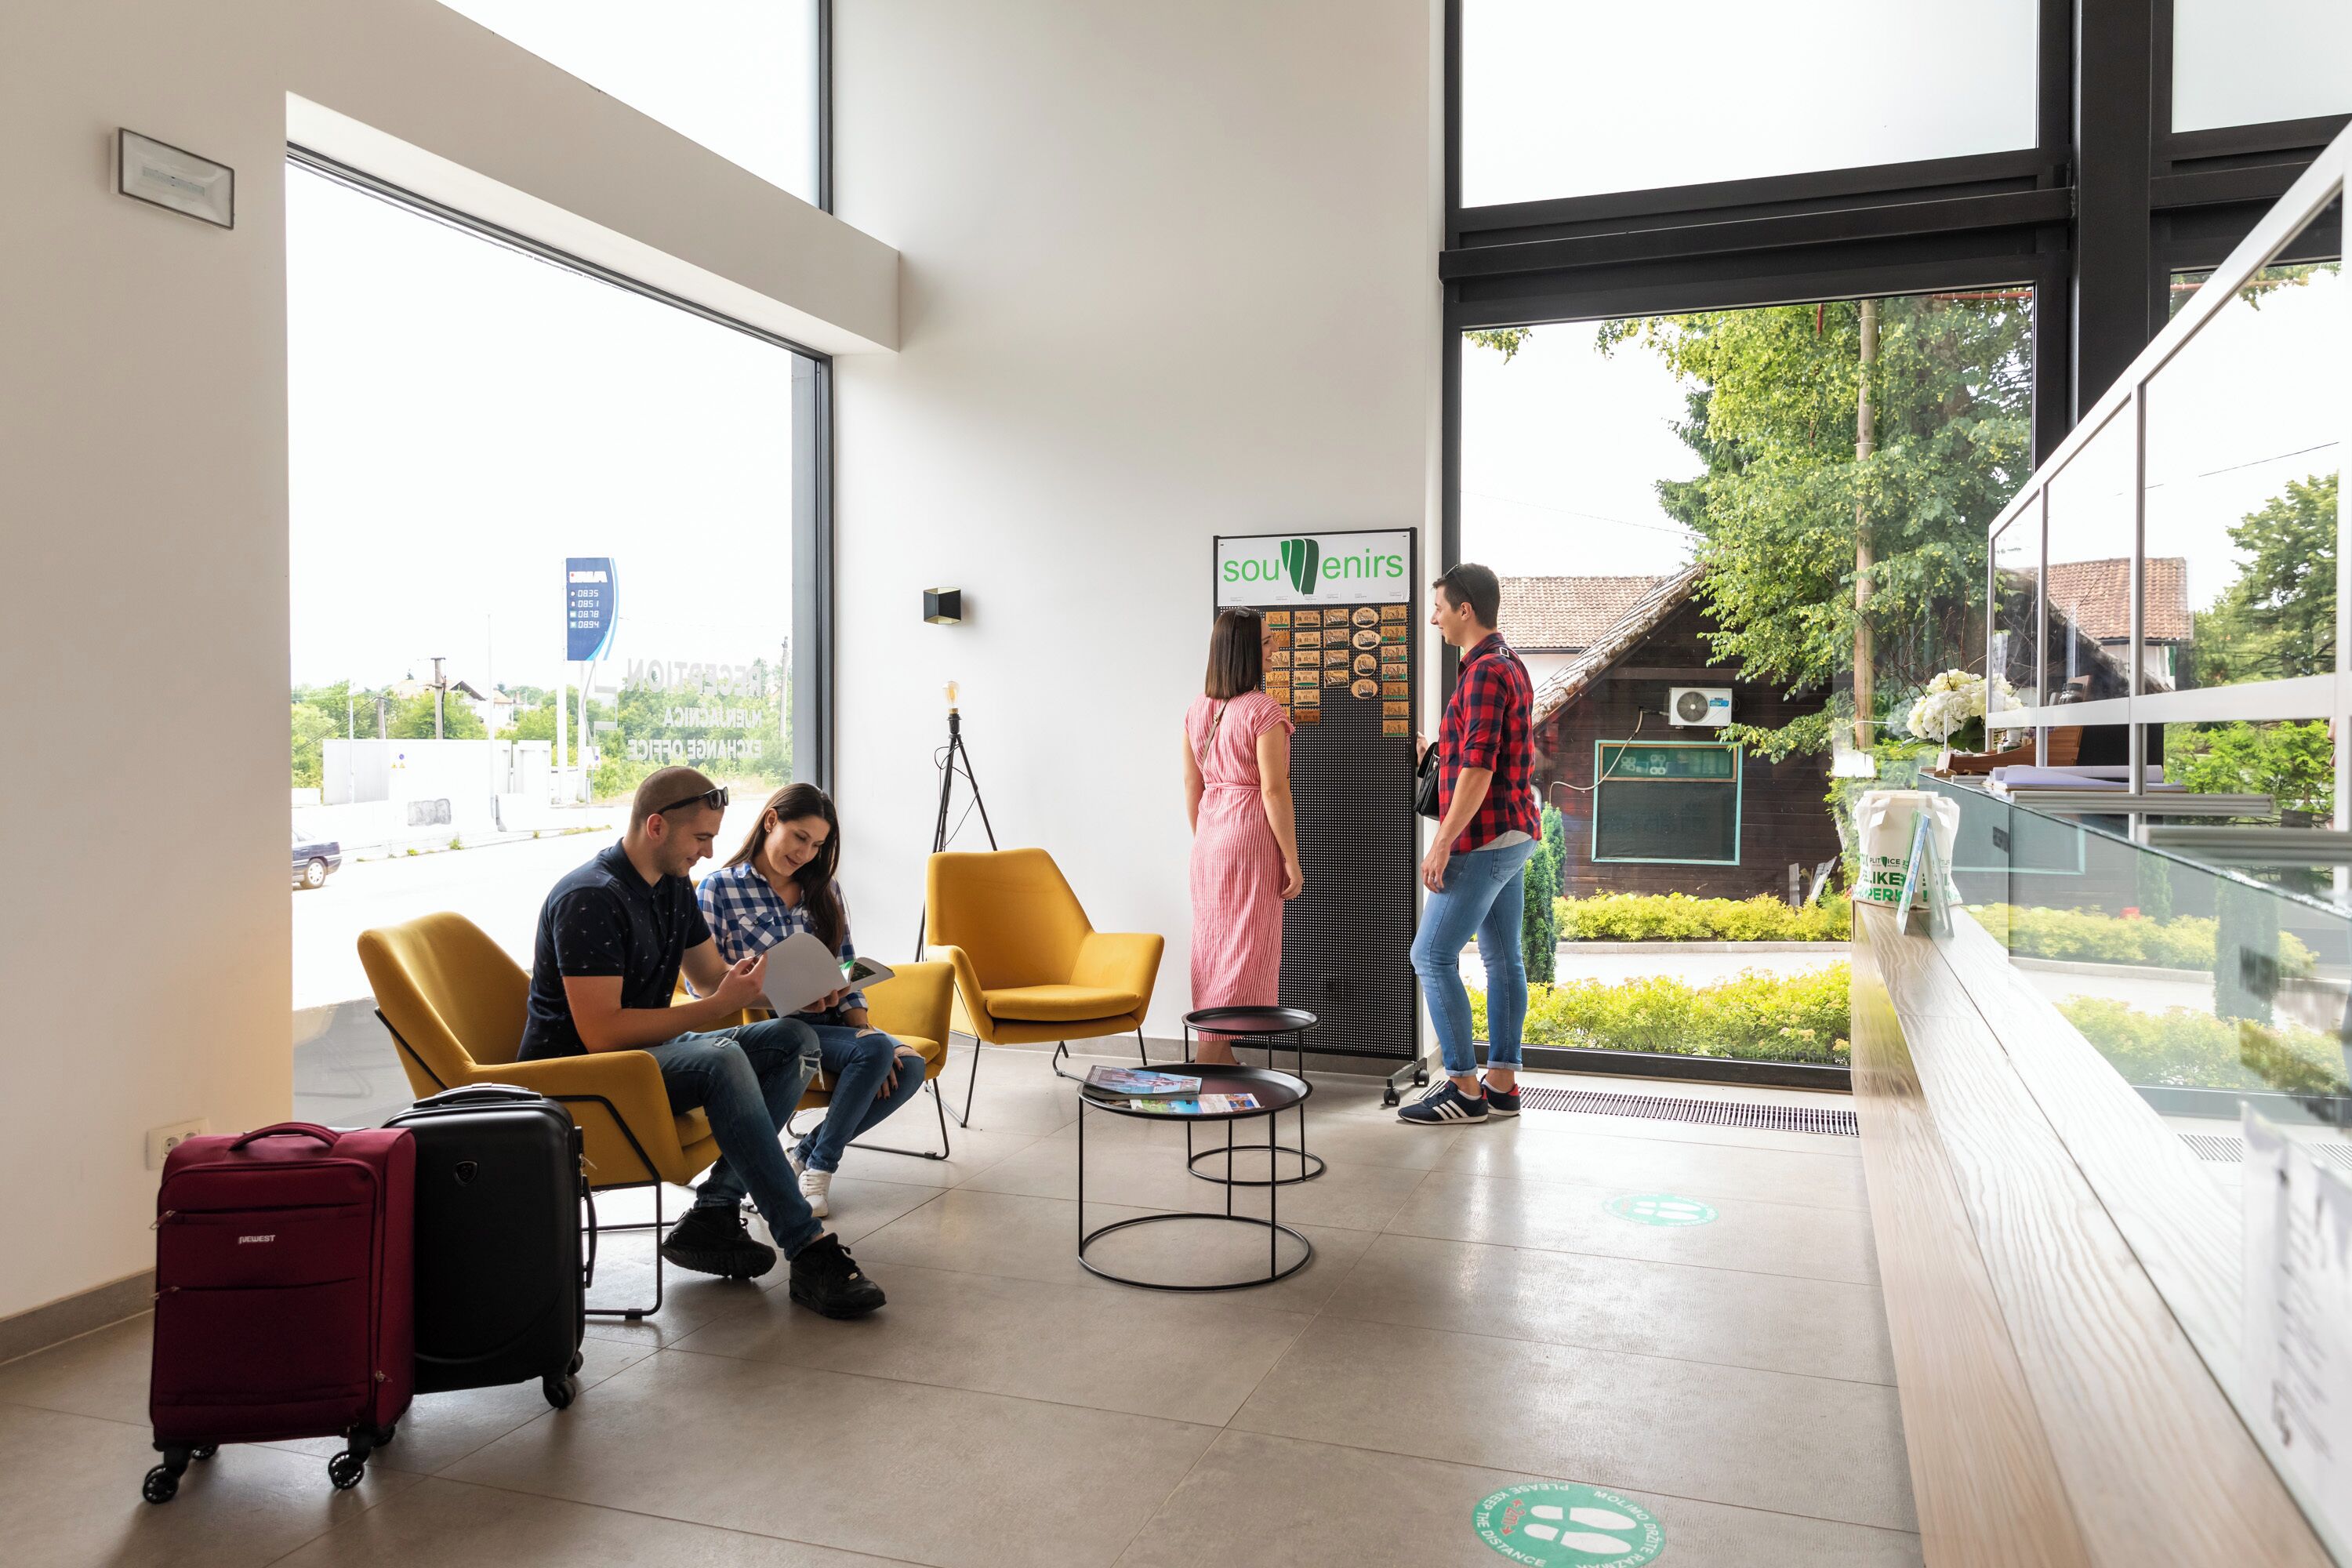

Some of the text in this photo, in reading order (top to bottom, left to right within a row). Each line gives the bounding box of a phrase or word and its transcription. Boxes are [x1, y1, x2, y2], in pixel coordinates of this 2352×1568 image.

[238, 1235, 276, 1244] NEWEST
[1593, 1490, 1650, 1520] MOLIMO
[1476, 1483, 1569, 1567] PLEASE KEEP THE DISTANCE
